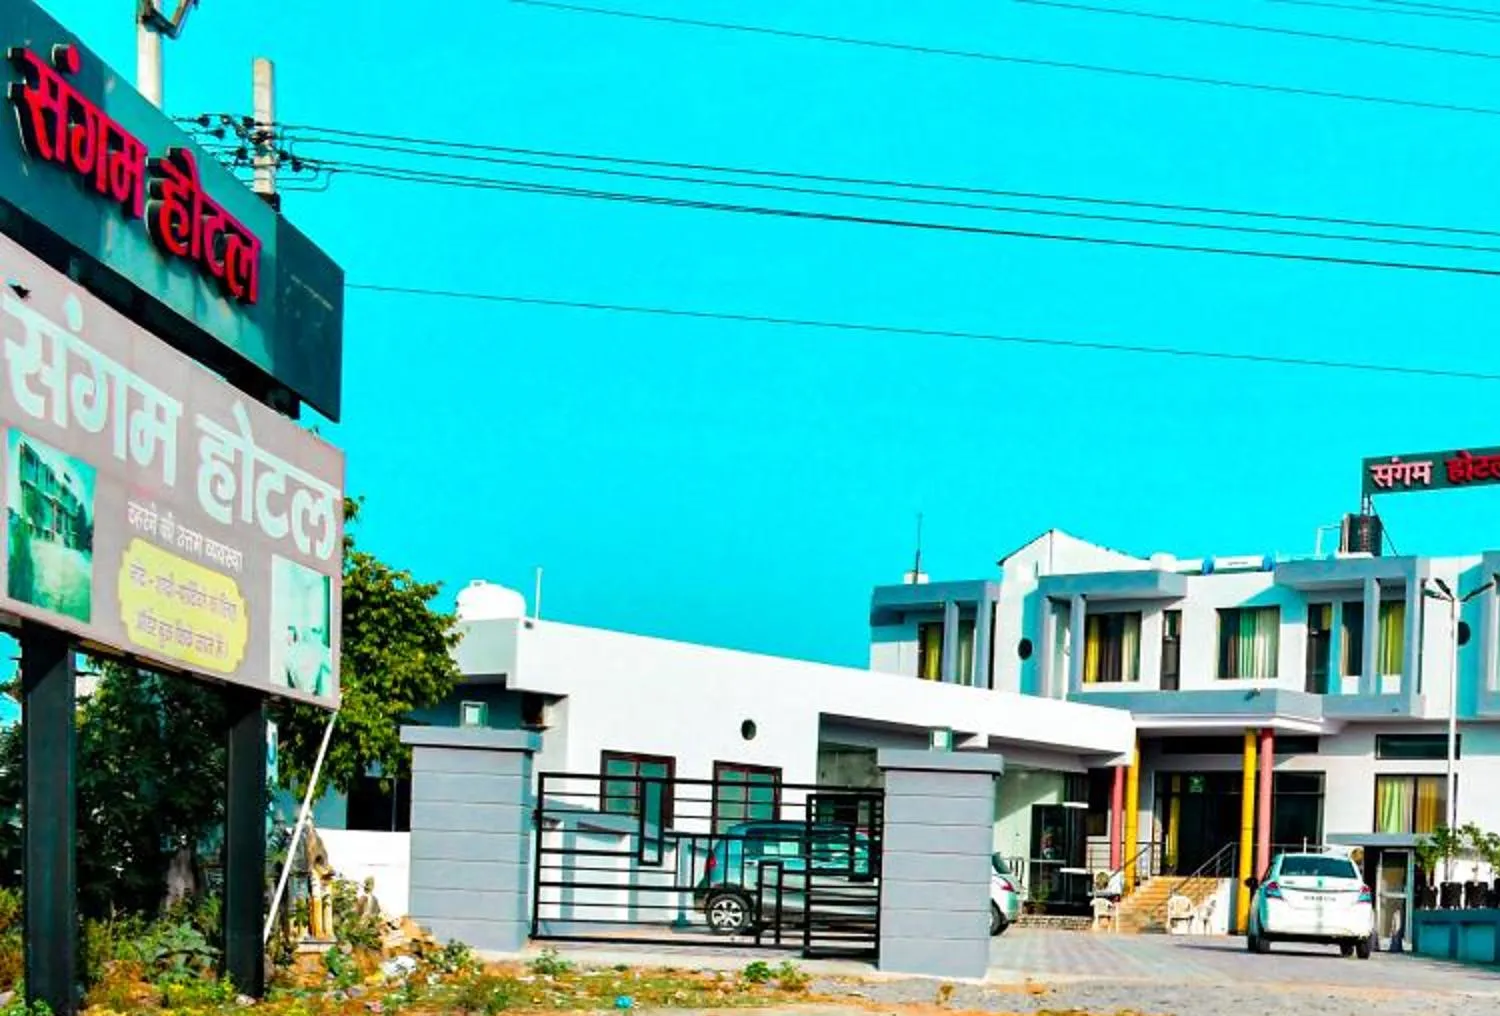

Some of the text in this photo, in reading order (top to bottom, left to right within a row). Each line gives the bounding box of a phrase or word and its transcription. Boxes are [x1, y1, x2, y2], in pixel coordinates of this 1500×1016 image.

[9, 43, 262, 305] संगम होटल
[0, 293, 341, 561] संगम होटल
[1369, 456, 1433, 488] संगम
